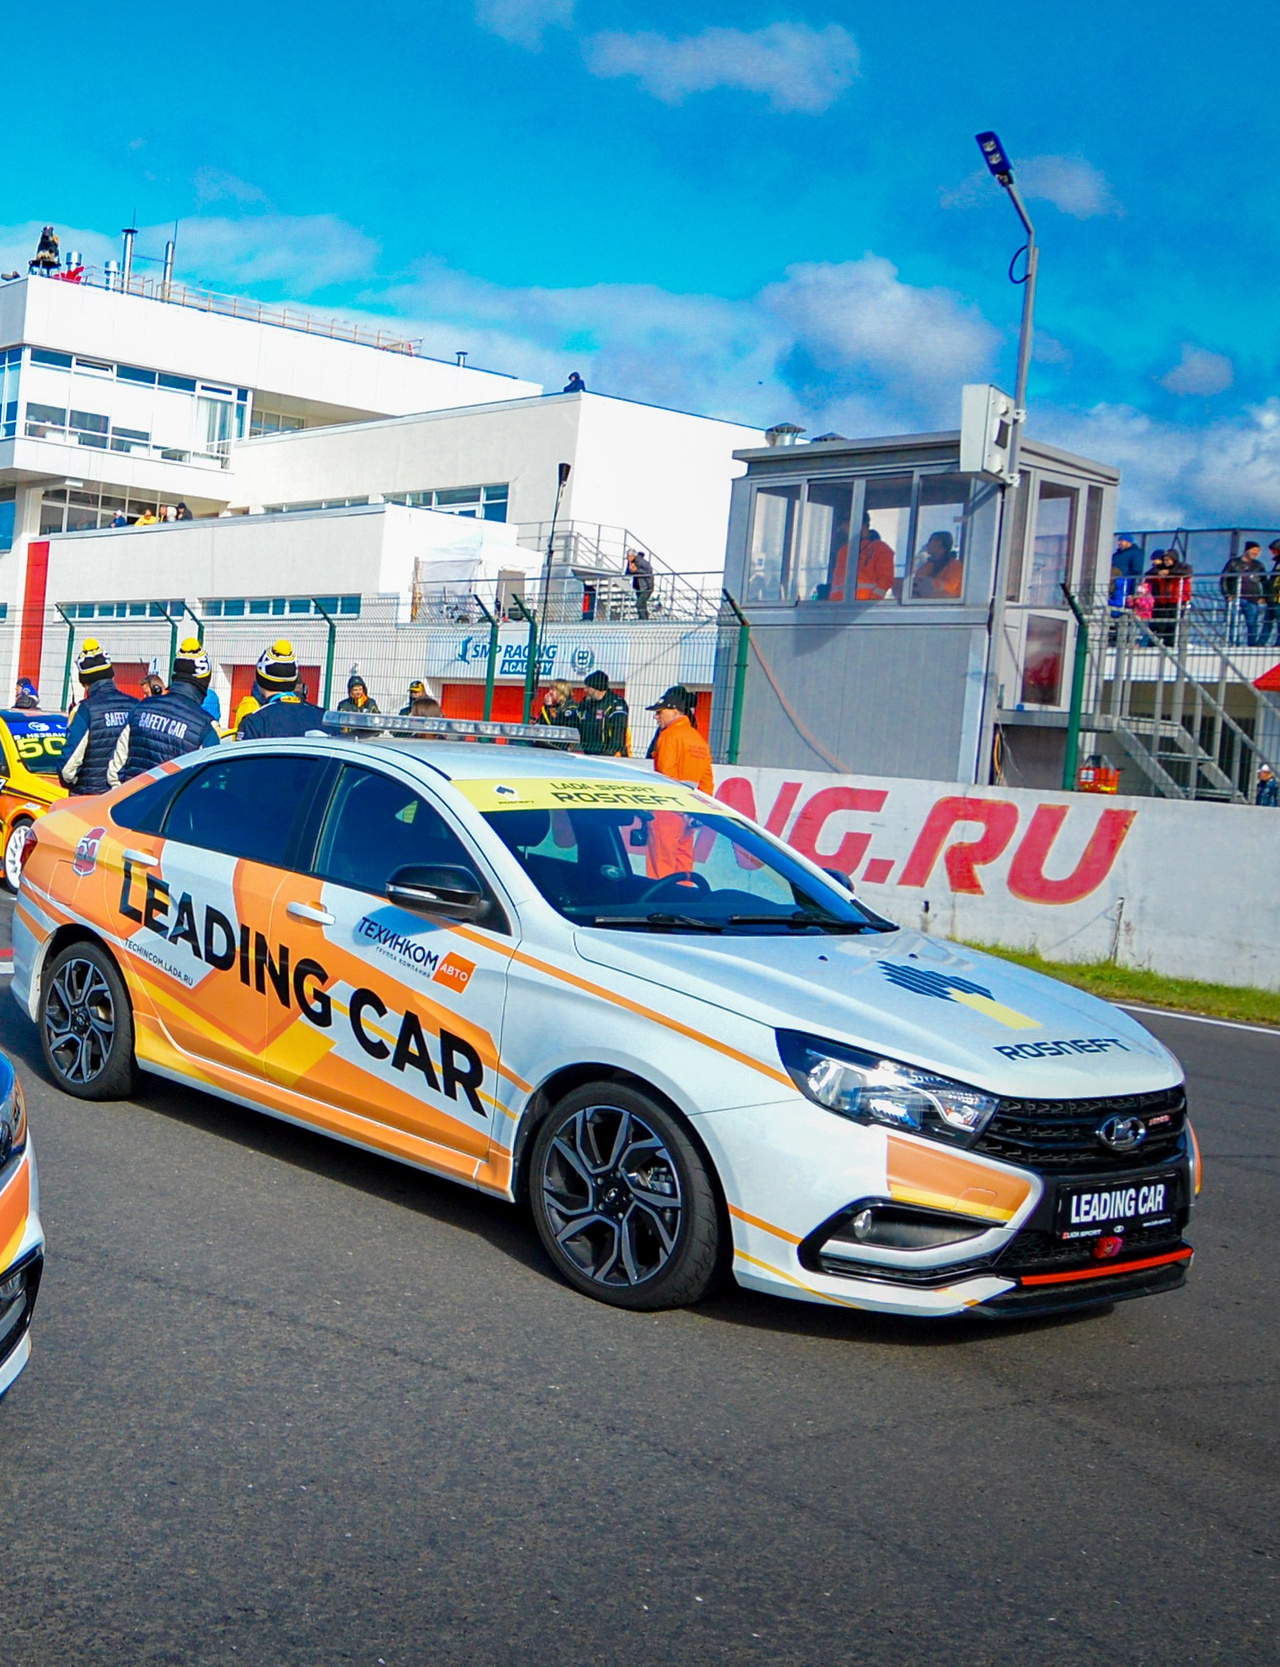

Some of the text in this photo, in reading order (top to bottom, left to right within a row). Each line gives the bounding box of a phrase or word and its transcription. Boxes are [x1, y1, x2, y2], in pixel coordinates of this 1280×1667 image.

[138, 712, 188, 740] SAFETY CAR
[16, 737, 67, 759] 50
[549, 782, 657, 793] LADA SPORT
[551, 792, 685, 807] ROSNEFT
[125, 938, 194, 986] TECHINCOM.LADA.RU
[358, 916, 469, 982] ТЕХИНКОМ АВТО
[118, 860, 489, 1118] LEADING CAR
[993, 1037, 1131, 1061] ROSNEFT
[1071, 1184, 1165, 1224] LEADING CAR
